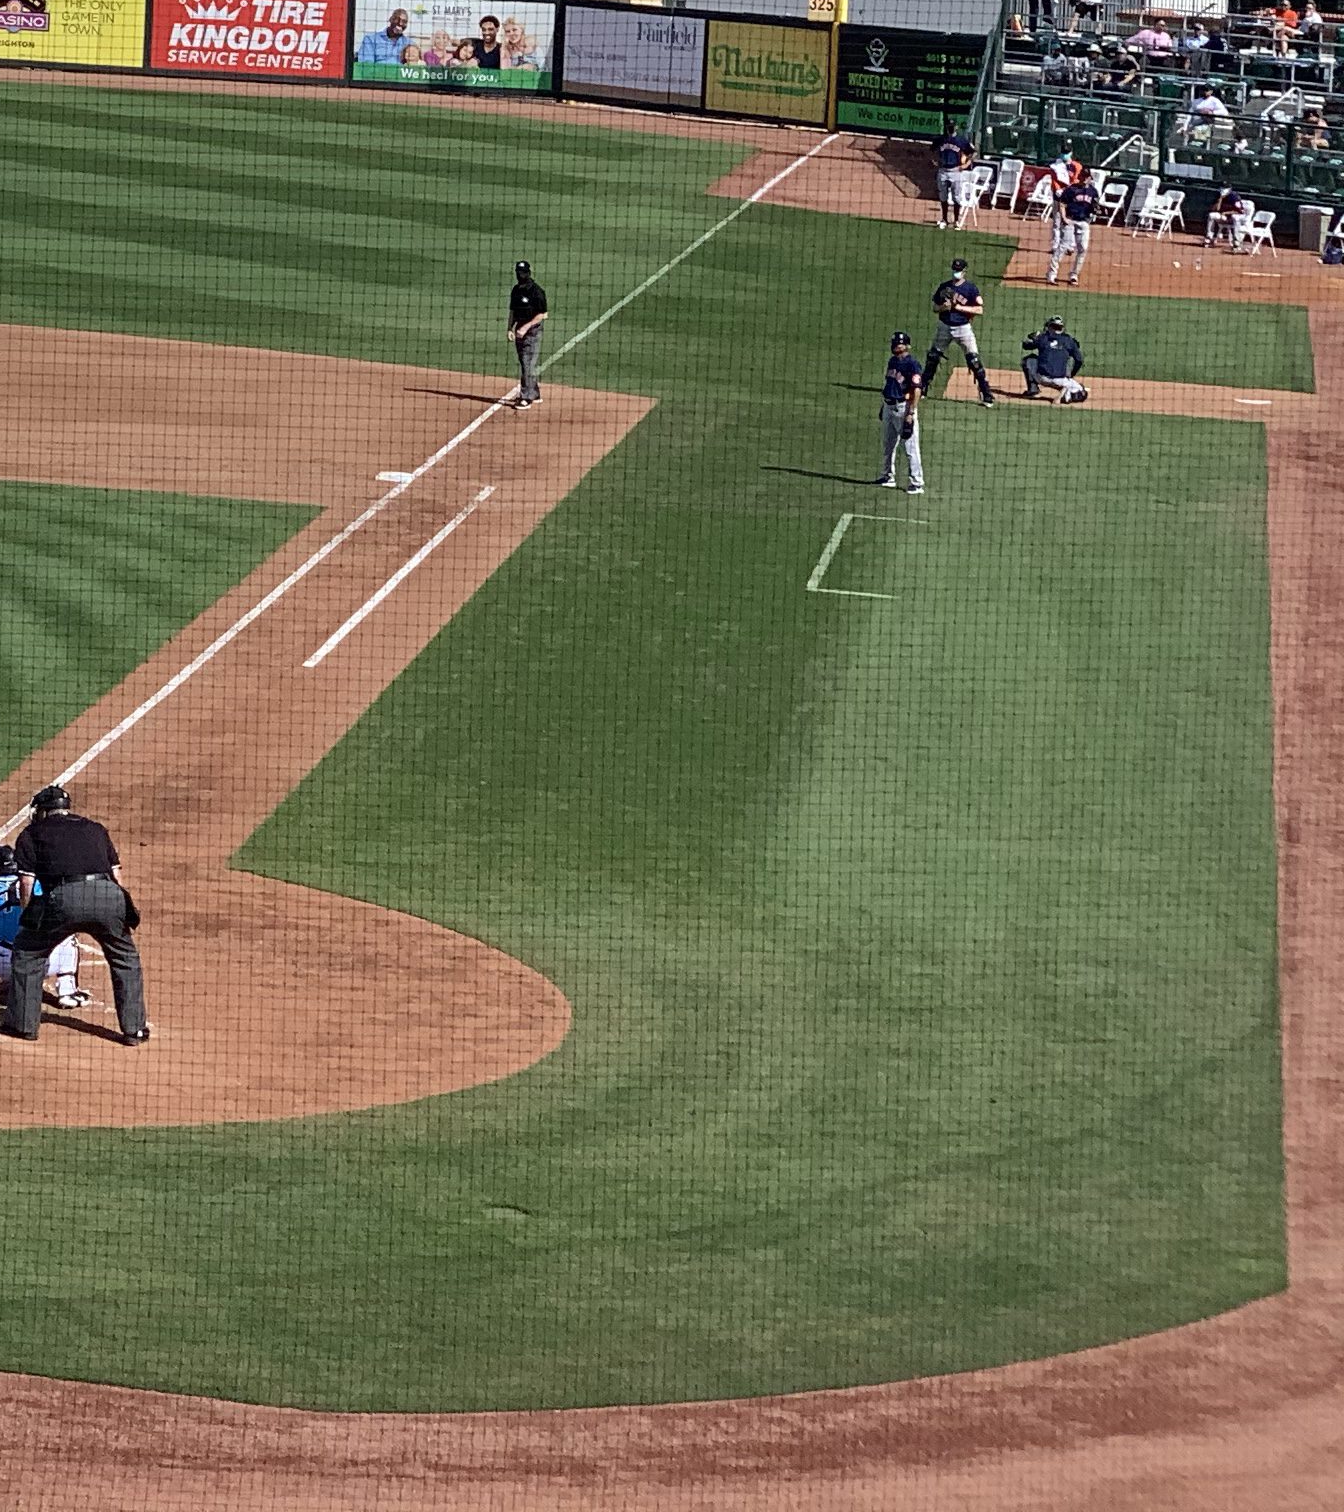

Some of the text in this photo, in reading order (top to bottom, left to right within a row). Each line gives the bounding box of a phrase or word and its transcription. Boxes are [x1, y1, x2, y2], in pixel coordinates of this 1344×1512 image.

[89, 0, 125, 12] ONLY
[62, 11, 115, 24] GAME IN
[168, 22, 329, 54] KINGDOM
[167, 49, 324, 71] SERVICE CENTERS
[711, 44, 822, 85] Nathan's
[400, 67, 468, 81] We heal for
[848, 72, 904, 91] WICKED CHEF
[876, 112, 904, 124] cook
